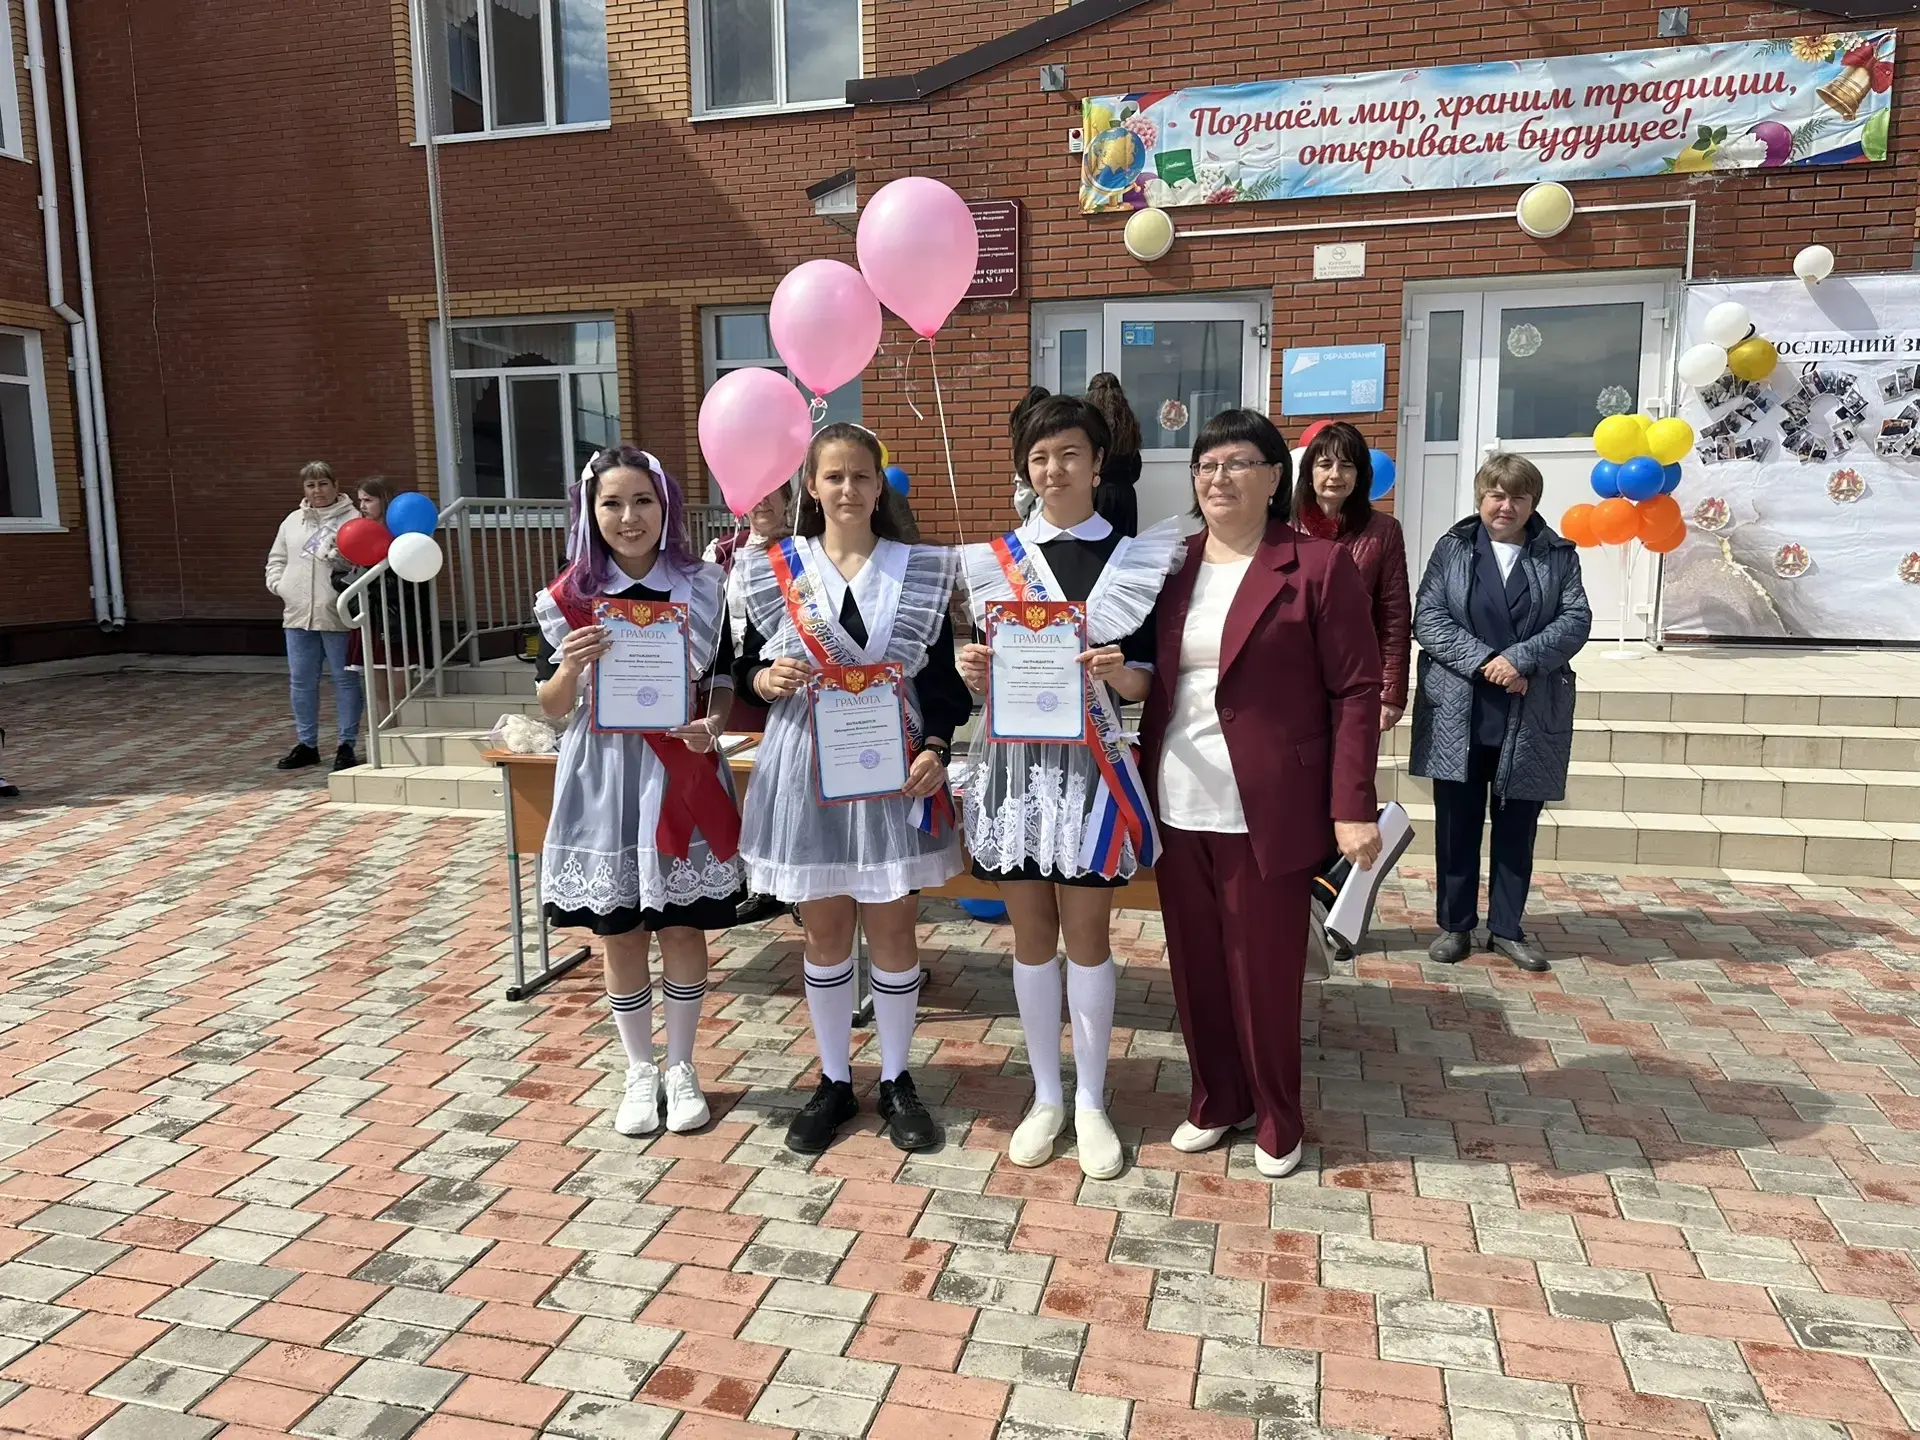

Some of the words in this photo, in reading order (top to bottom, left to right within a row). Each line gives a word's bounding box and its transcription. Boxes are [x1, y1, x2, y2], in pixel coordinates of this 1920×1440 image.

[1190, 99, 1341, 147] Познаём
[1350, 97, 1426, 135] мир,
[1434, 87, 1575, 130] храним
[1583, 70, 1797, 118] традиции,
[1299, 123, 1508, 174] открываем
[1517, 108, 1692, 163] будущее!
[995, 275, 1003, 283] 14
[1771, 335, 1896, 355] ОСЛЕДНИЙ
[1323, 351, 1377, 360] ОБРАЗОВАНИЕ
[620, 628, 667, 640] ГРАМОТА
[1013, 633, 1062, 644] ГРАМОТА
[835, 695, 881, 708] ГРАМОТА
